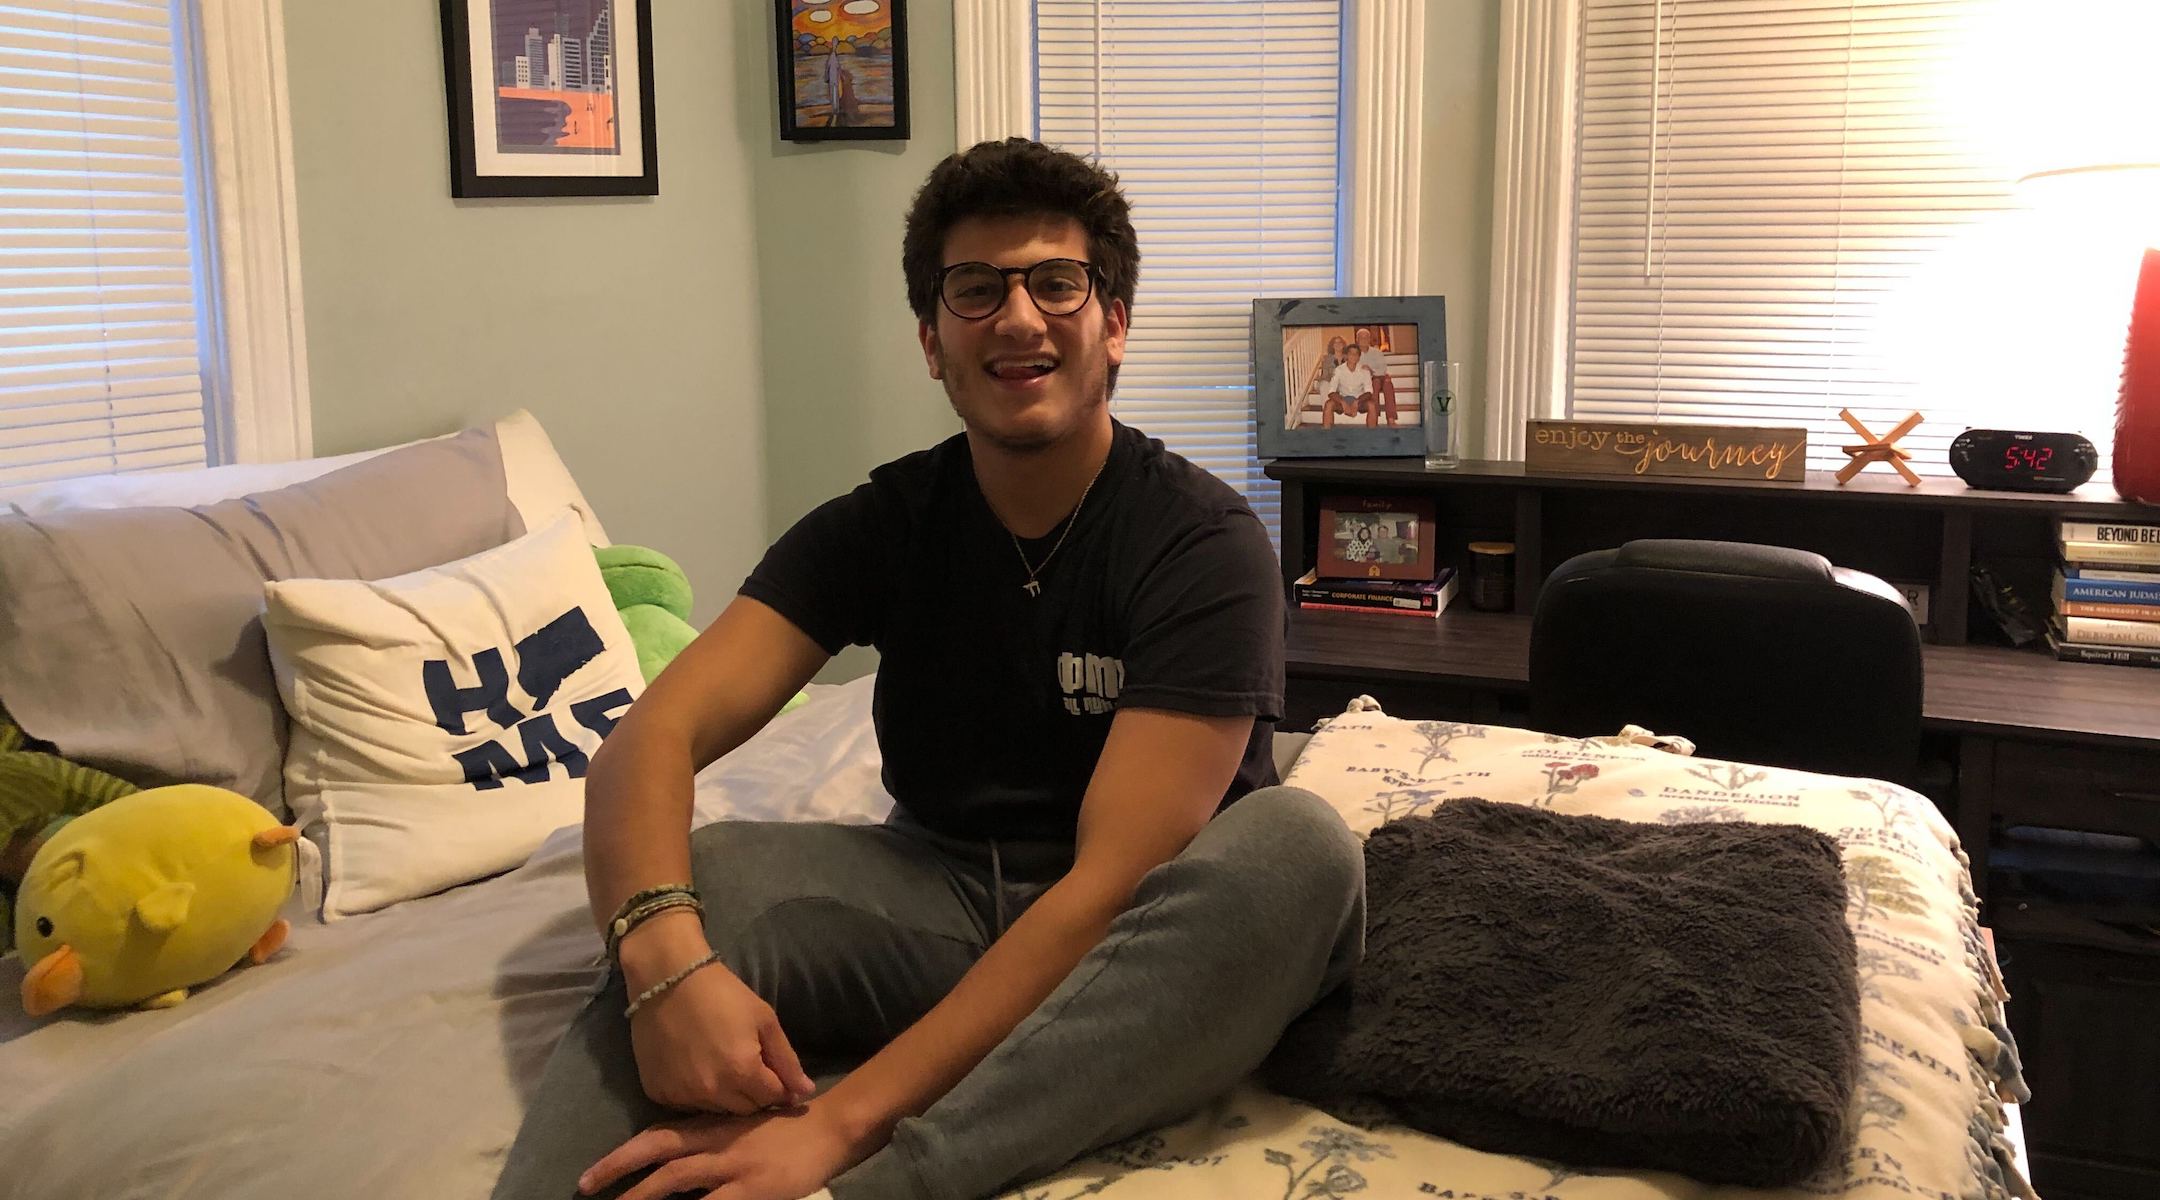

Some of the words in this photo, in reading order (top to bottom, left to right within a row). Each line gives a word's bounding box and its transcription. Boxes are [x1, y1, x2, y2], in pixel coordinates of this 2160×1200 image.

[1437, 396, 1452, 413] V
[1535, 426, 1611, 450] enjoy
[1616, 431, 1645, 445] the
[1614, 429, 1806, 480] journey
[2004, 446, 2053, 470] 5:42
[2097, 526, 2138, 542] BEYOND
[1331, 592, 1367, 601] CORPORATE
[1367, 594, 1394, 602] FINANCE
[2073, 587, 2127, 599] AMERICAN
[2096, 606, 2139, 615] HOLOCAUST
[1663, 786, 1800, 802] DANDELION
